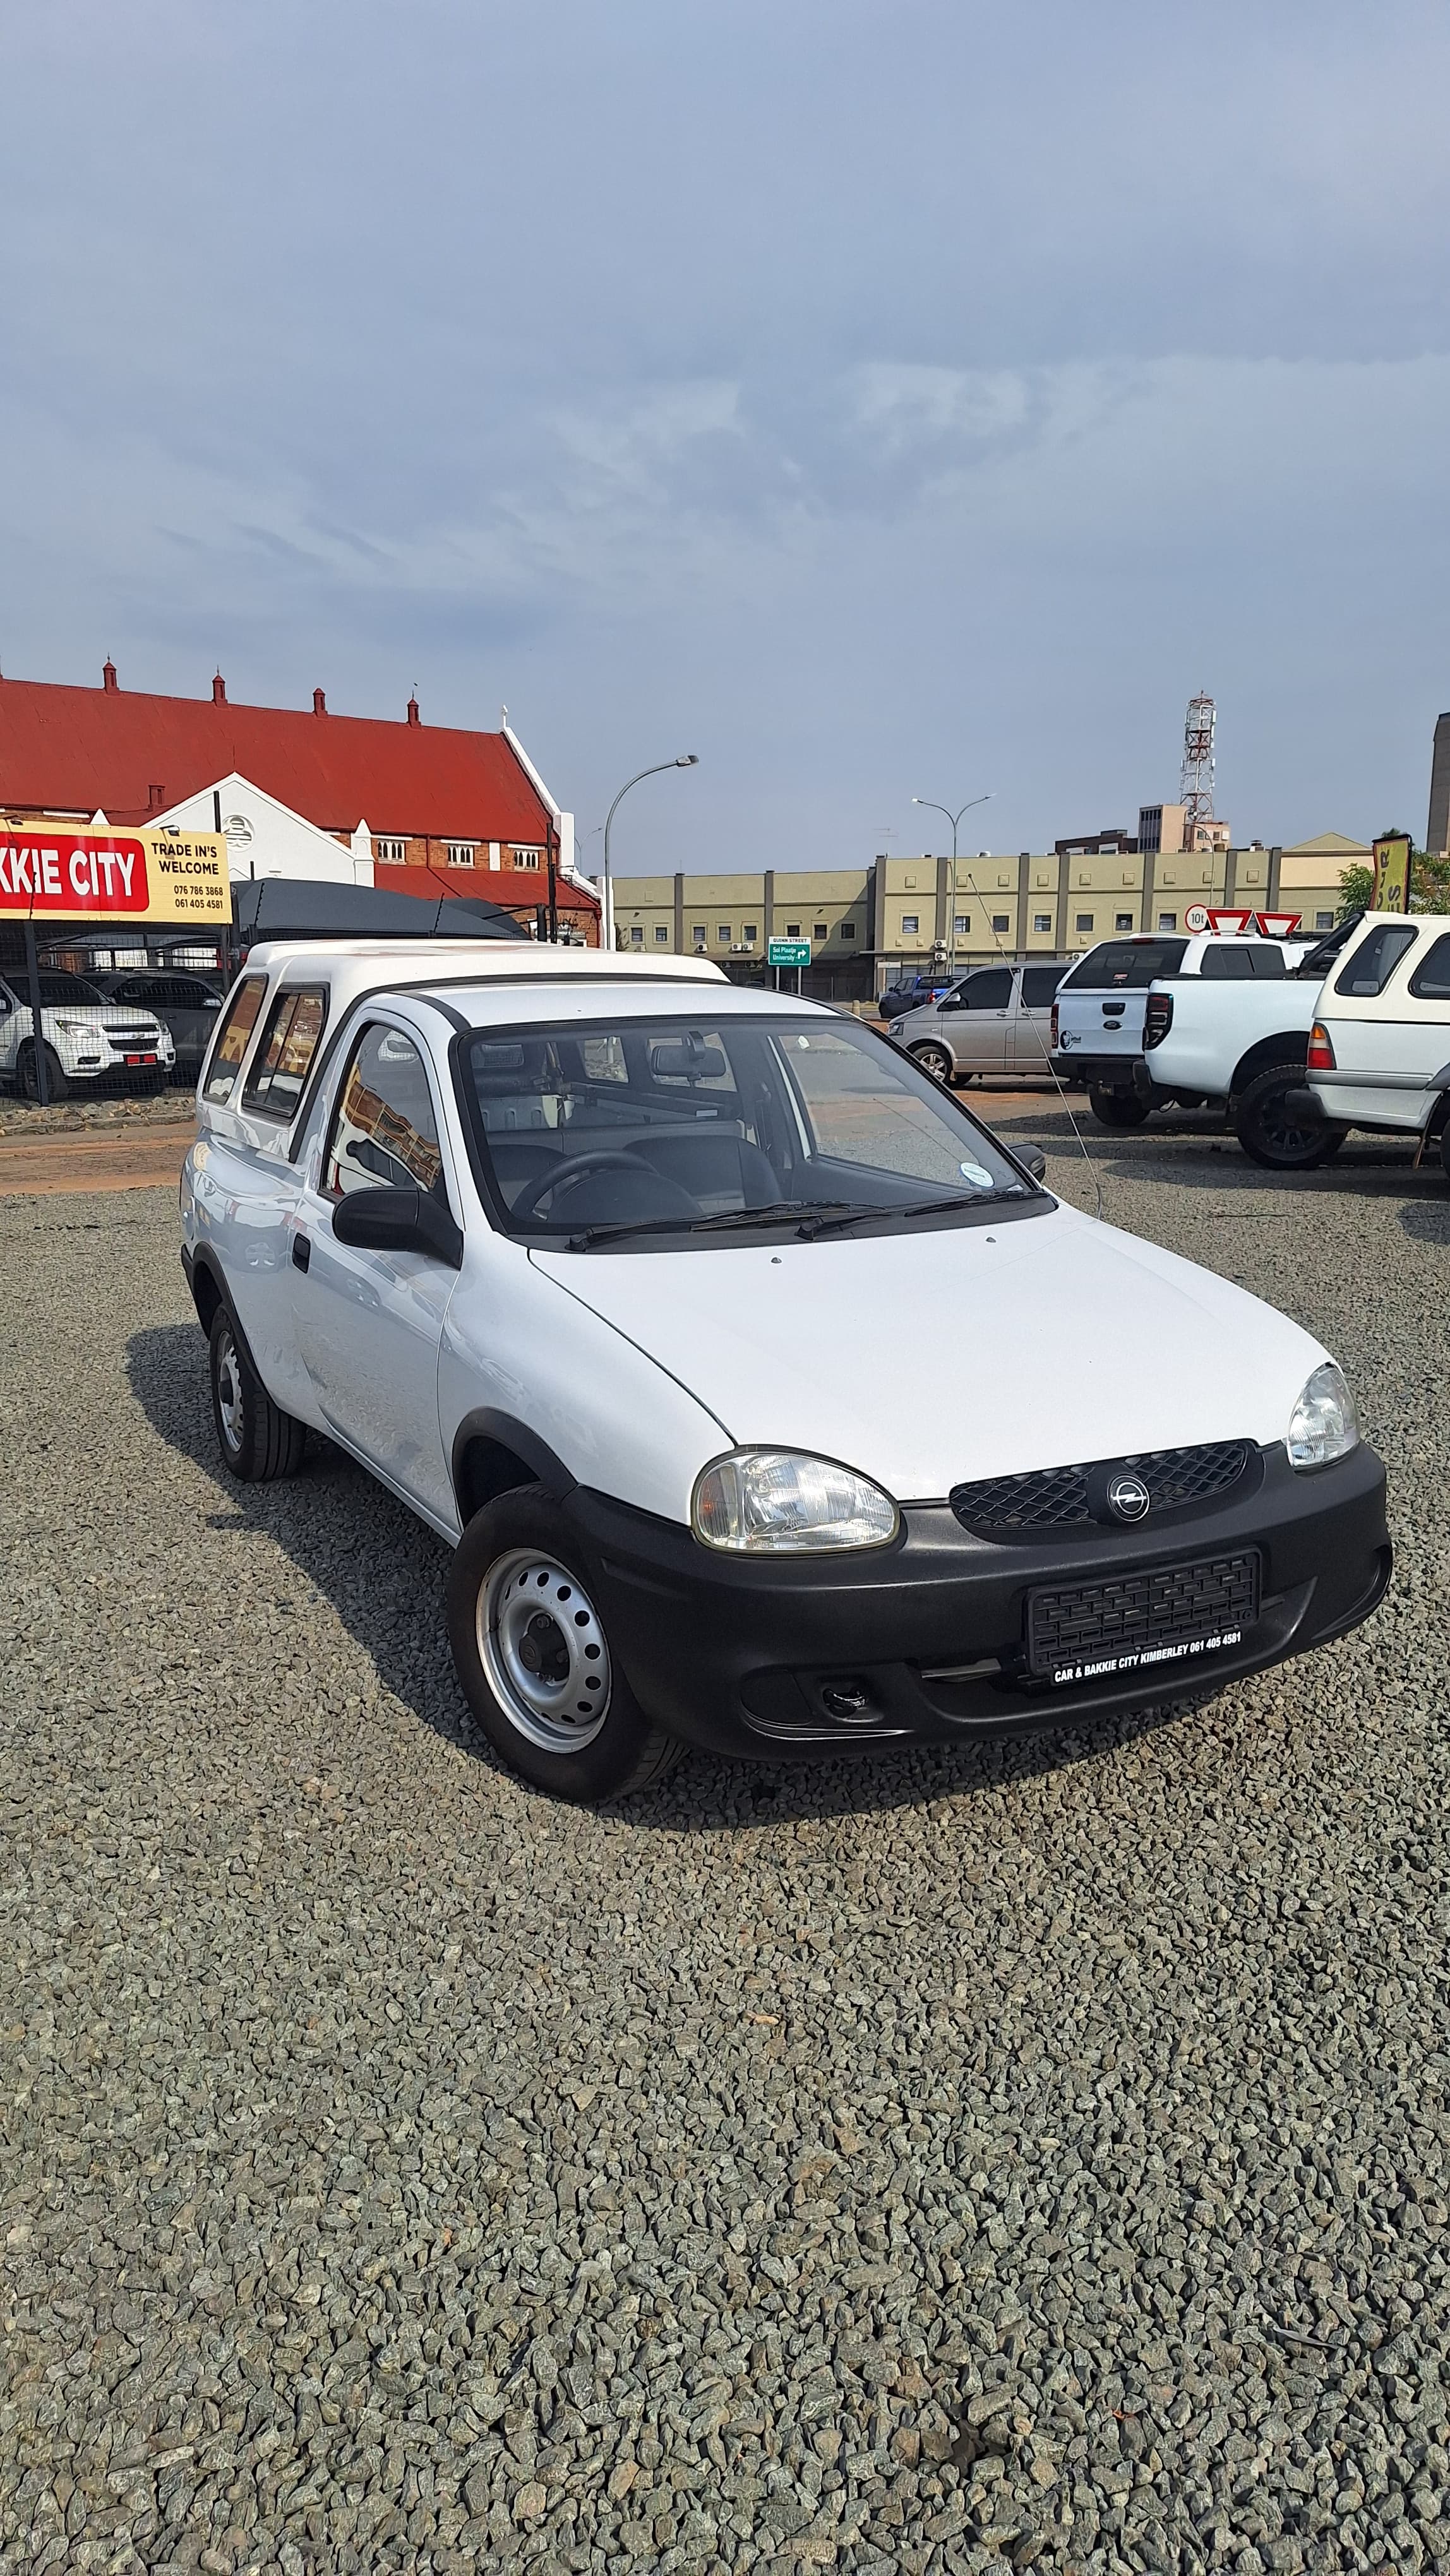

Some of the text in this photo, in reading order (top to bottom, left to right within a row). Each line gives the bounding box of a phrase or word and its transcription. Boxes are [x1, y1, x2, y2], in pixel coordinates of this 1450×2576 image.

[151, 842, 217, 857] TRADE IN'S
[69, 850, 135, 896] CITY
[159, 860, 219, 874] WELCOME
[174, 885, 223, 896] 076 786 3868
[175, 898, 223, 909] 061 405 4581
[1191, 913, 1204, 924] 10t
[1055, 1631, 1241, 1683] CAR & BAKKIE CITY KIMBERLEY 061 405 4581
